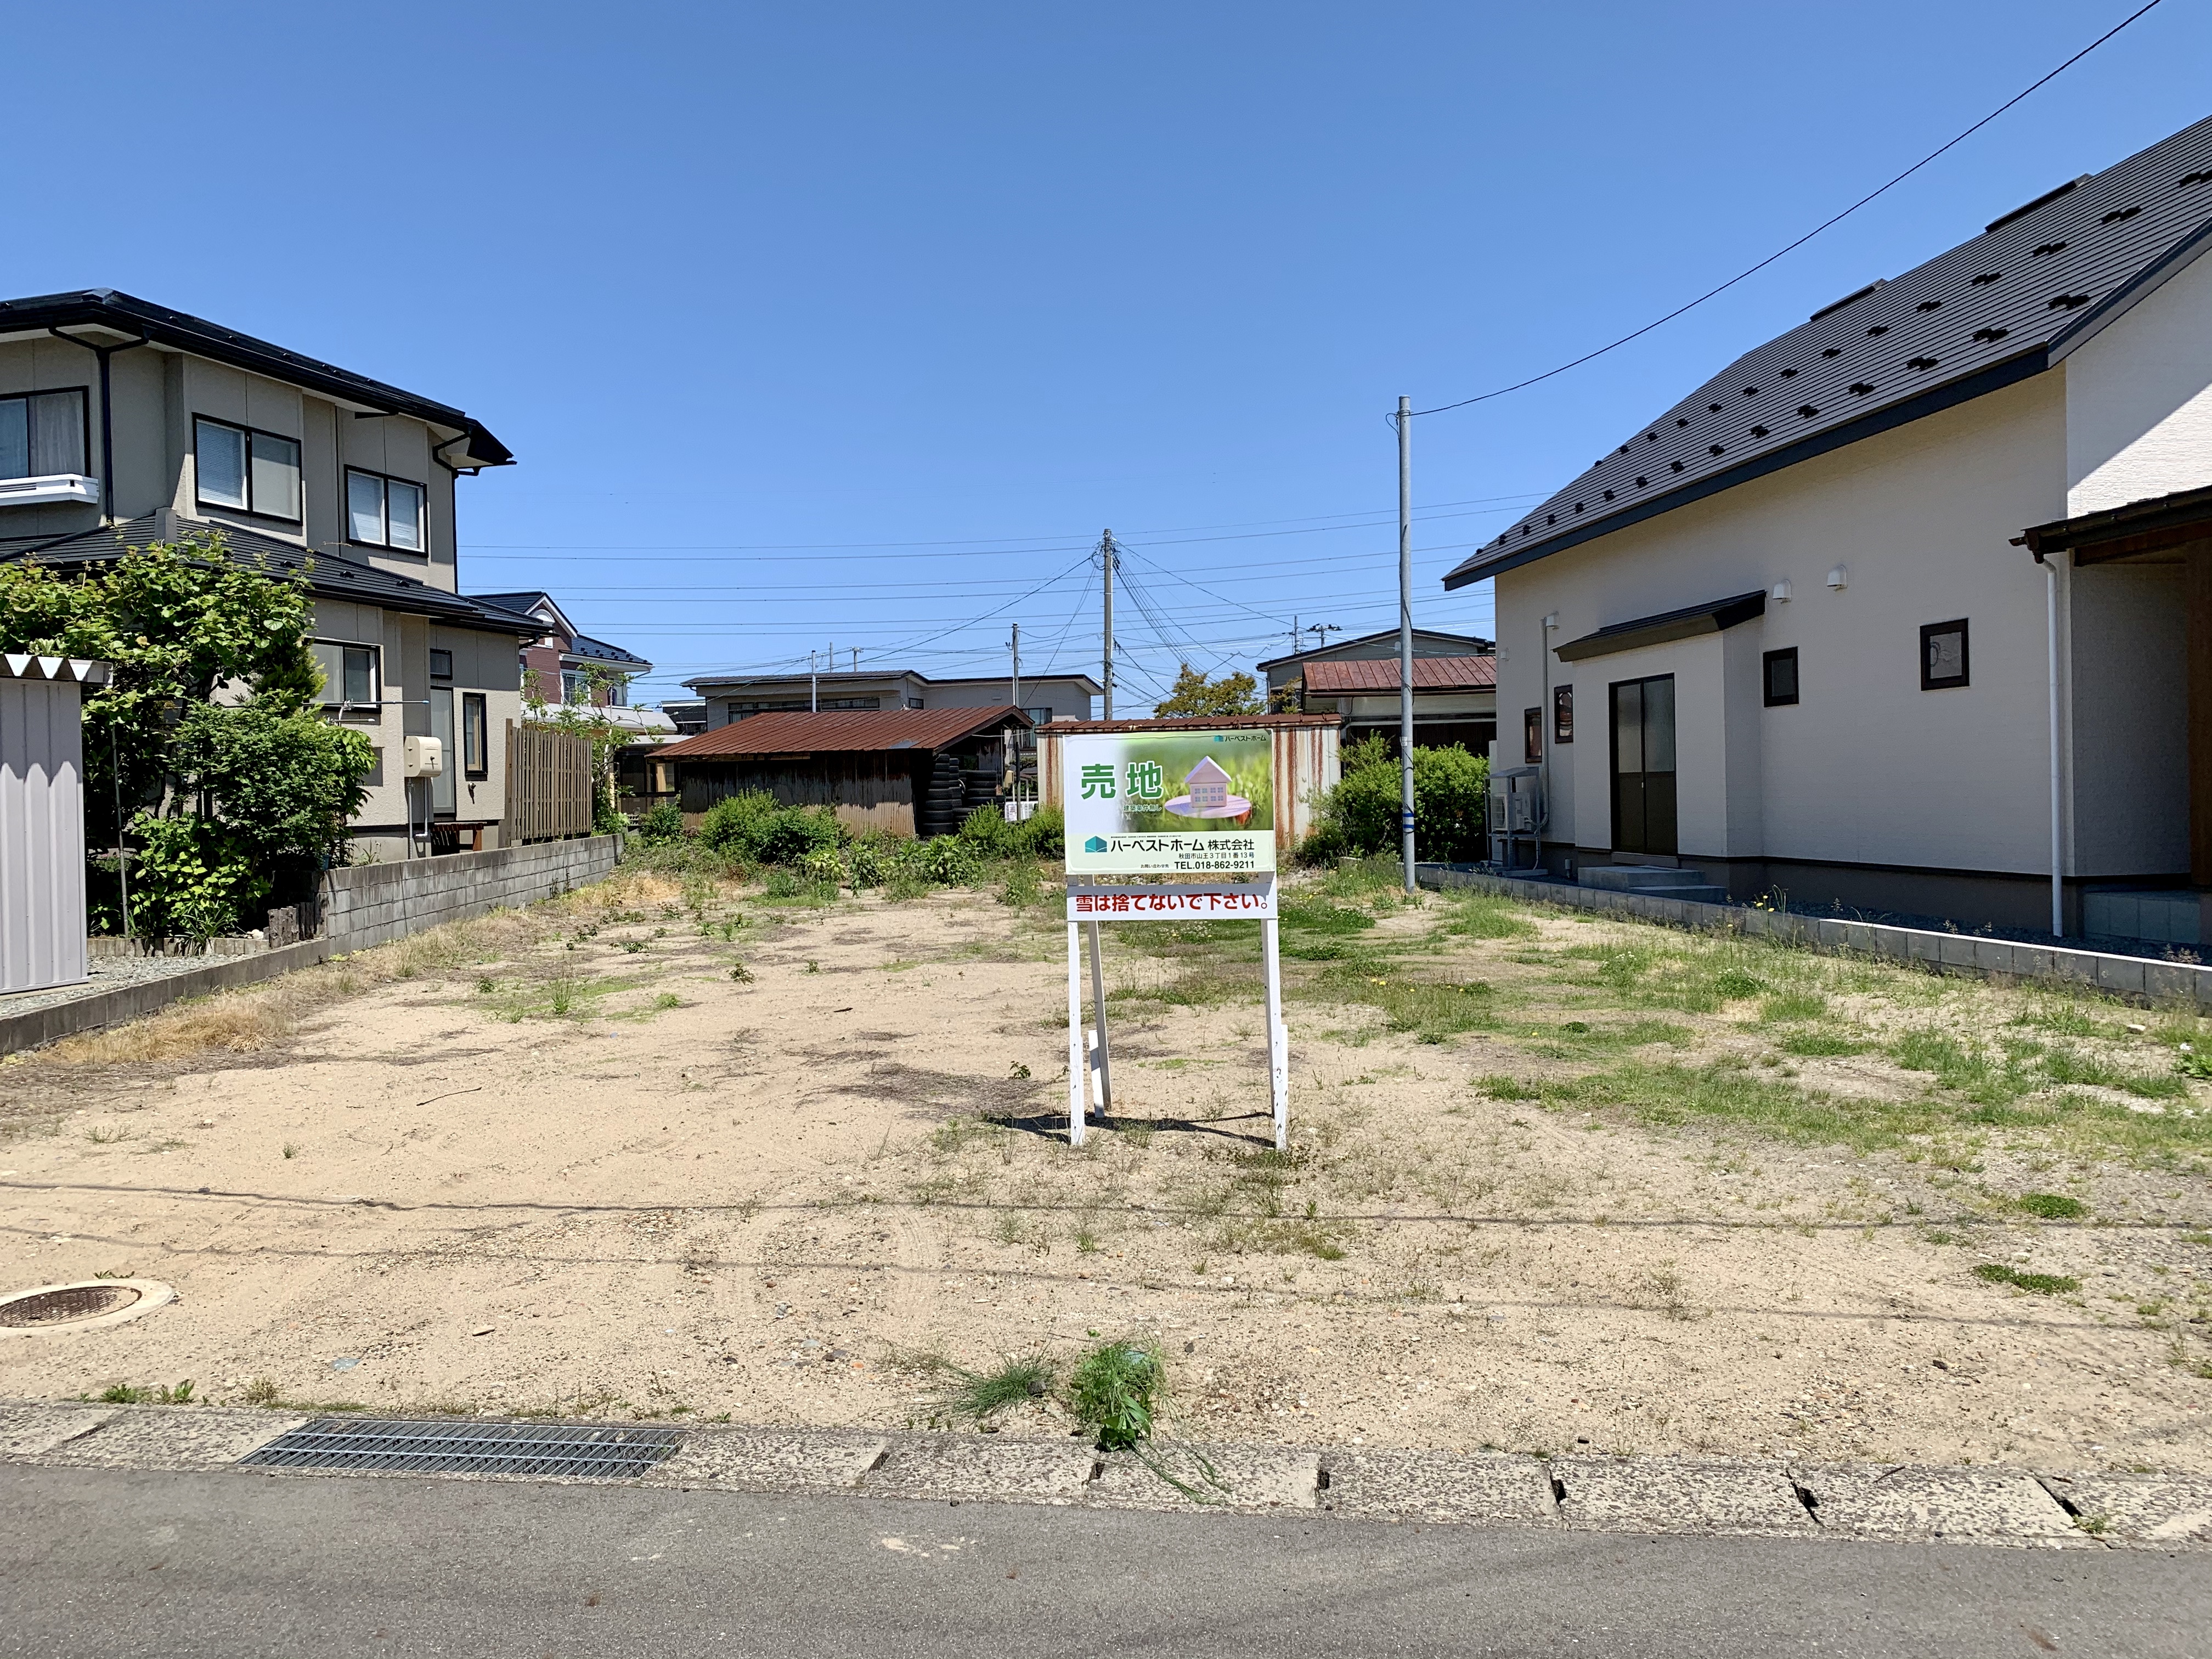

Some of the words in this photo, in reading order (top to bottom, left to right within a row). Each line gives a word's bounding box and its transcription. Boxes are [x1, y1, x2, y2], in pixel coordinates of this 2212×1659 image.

[1081, 761, 1163, 799] 売地
[1110, 839, 1205, 852] ハーベストホーム
[1207, 839, 1255, 851] 株式会社
[1174, 861, 1255, 870] TEL.018-862-9211
[1076, 893, 1268, 912] 雪は捨てないで下さい。
